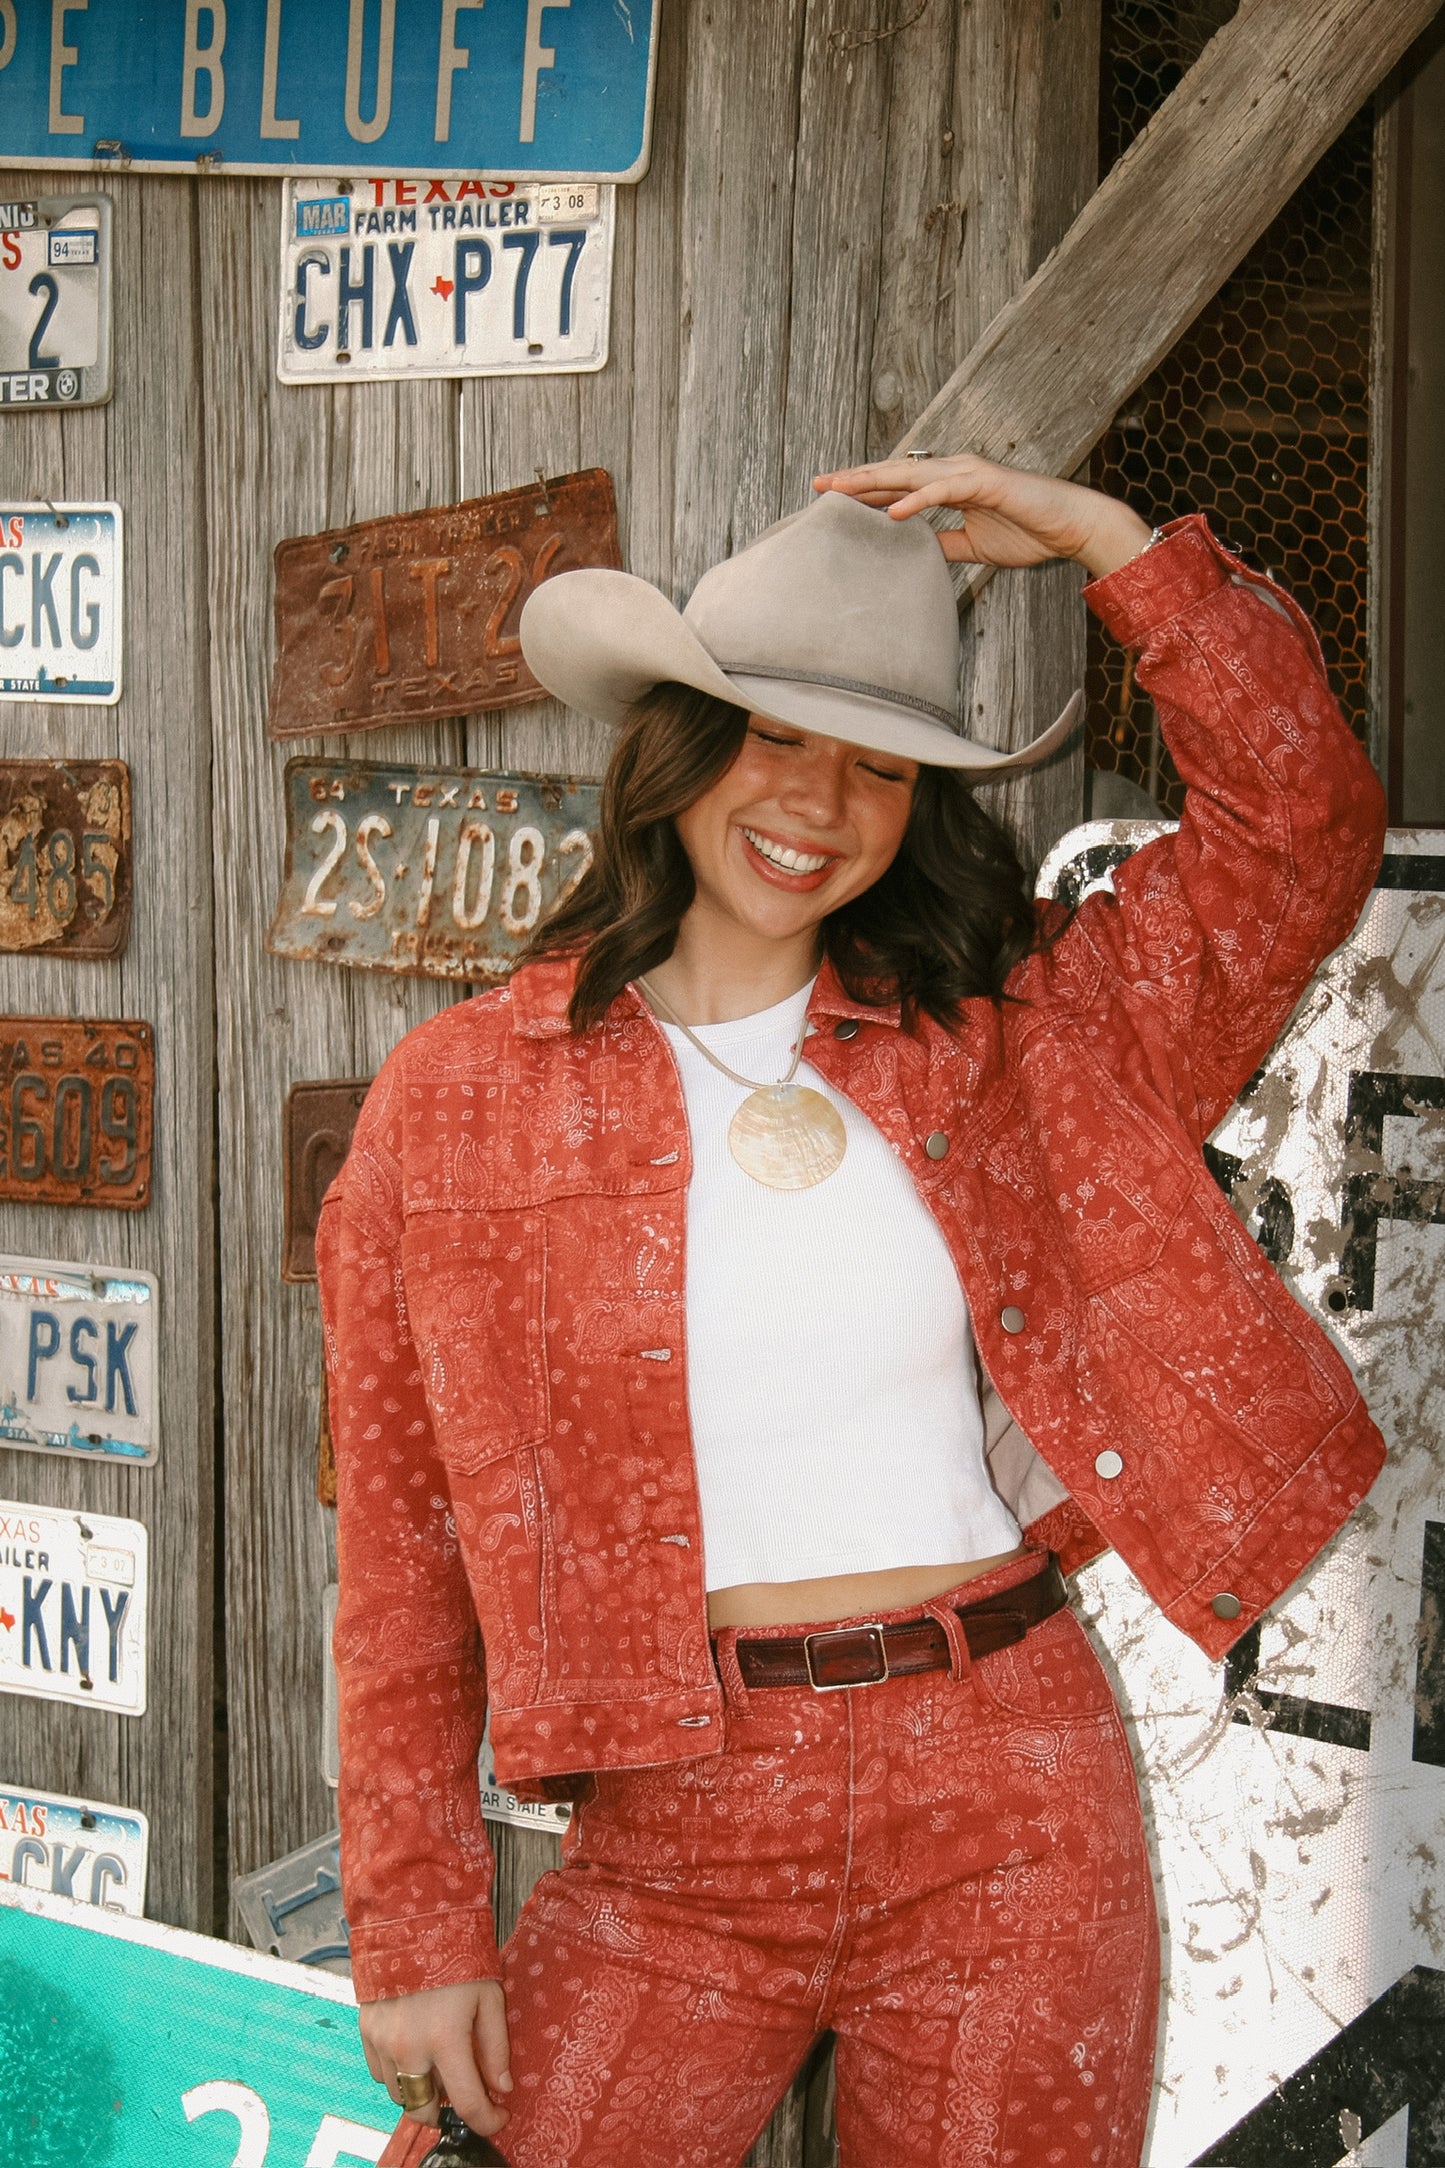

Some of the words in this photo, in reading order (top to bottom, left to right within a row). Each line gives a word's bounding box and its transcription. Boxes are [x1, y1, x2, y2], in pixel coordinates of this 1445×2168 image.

[180, 0, 572, 144] BLUFF
[368, 178, 516, 207] TEXAS
[568, 194, 585, 209] 08
[302, 202, 347, 231] MAR
[354, 208, 417, 236] FARM
[428, 200, 529, 231] TRAILER
[53, 241, 70, 258] 94
[294, 241, 418, 351] CHX
[454, 230, 587, 345] P77
[28, 272, 60, 370] 2
[0, 552, 101, 650] CKG
[10, 680, 40, 692] STATE
[371, 661, 520, 702] TEXAS
[388, 783, 519, 813] TEXAS
[11, 830, 116, 919] 485
[85, 1041, 138, 1069] 40
[11, 1072, 138, 1185] 609
[26, 1309, 138, 1417] PSK
[0, 1546, 49, 1572] ILER
[22, 1575, 130, 1683] KNY
